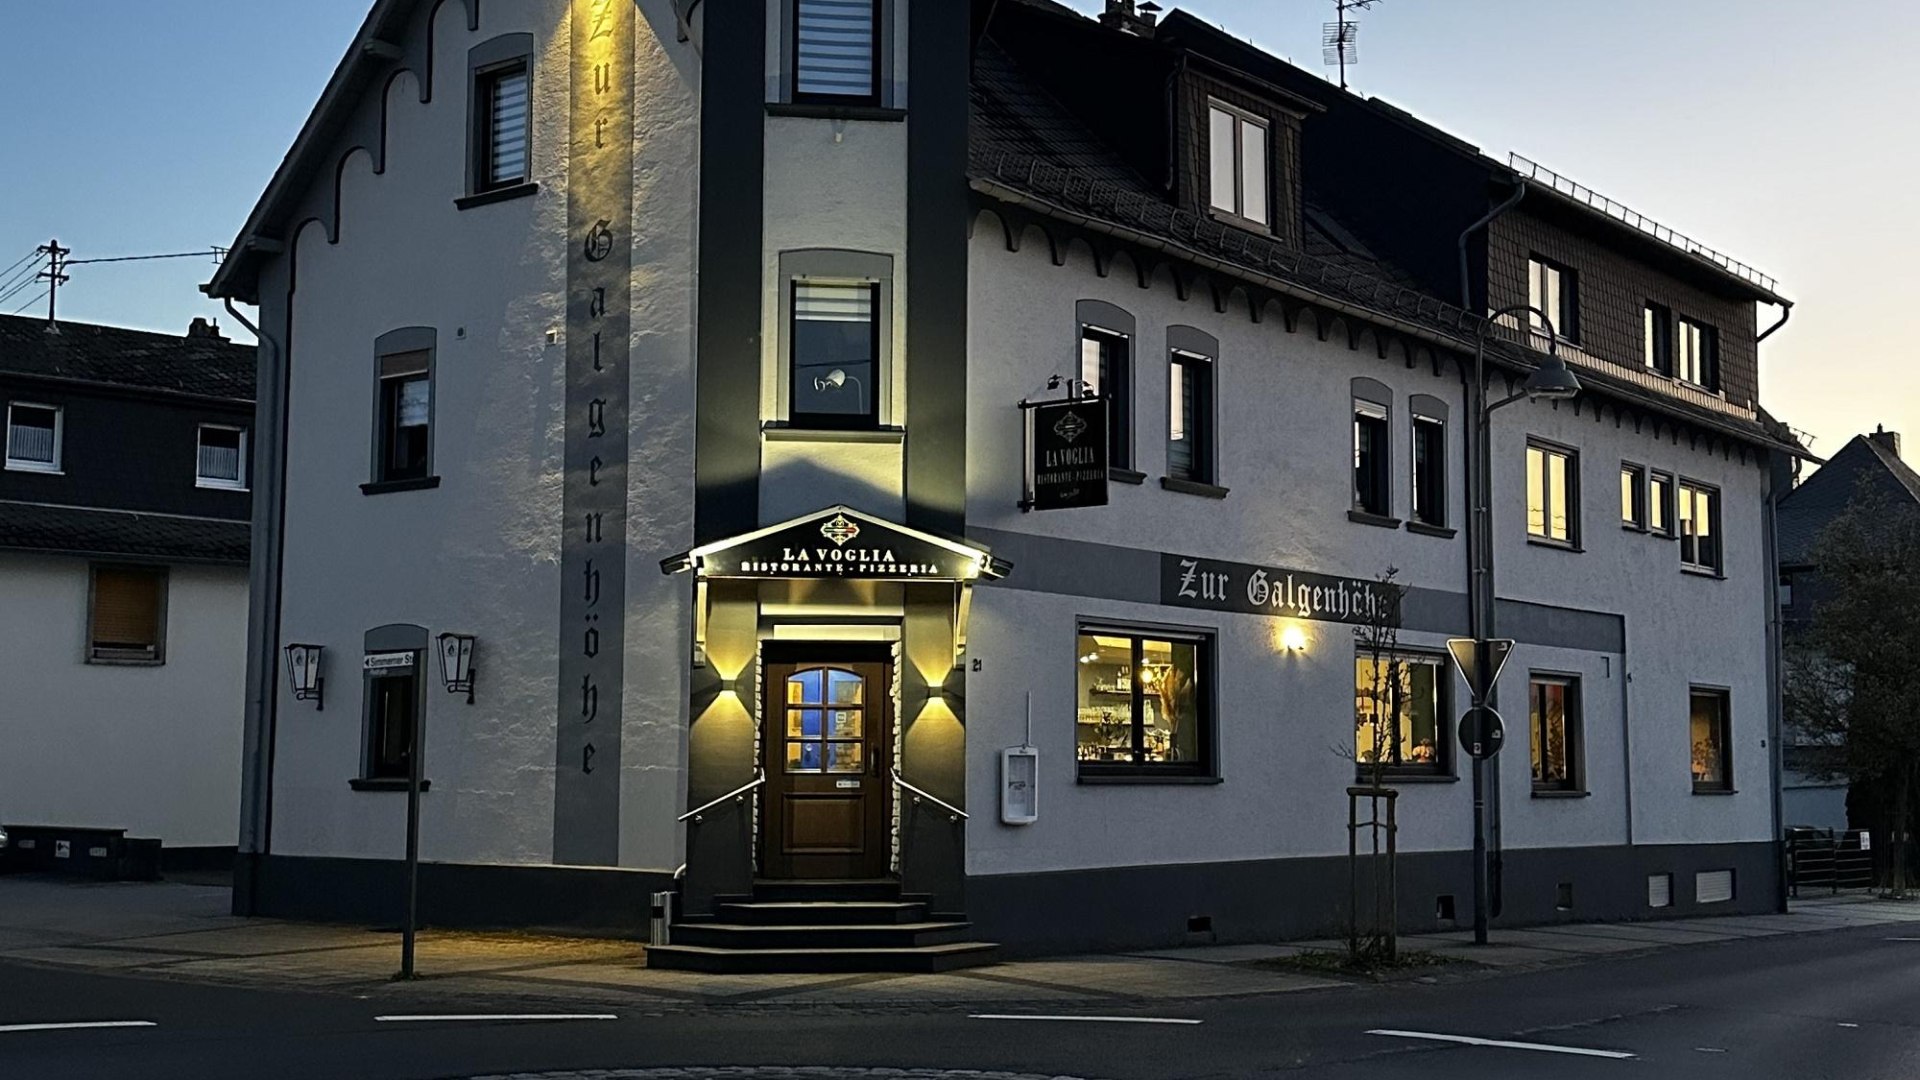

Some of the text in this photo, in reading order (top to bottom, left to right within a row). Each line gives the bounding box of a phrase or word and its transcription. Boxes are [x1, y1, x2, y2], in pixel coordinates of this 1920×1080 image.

[581, 0, 615, 776] Zur Galgenhöhe
[1046, 447, 1094, 467] LA VOGLIA
[783, 548, 896, 562] LA VOGLIA
[741, 561, 844, 573] RISTORANTE
[859, 564, 938, 574] PIZZERIA
[1178, 559, 1229, 601] Zur
[972, 658, 982, 672] 21
